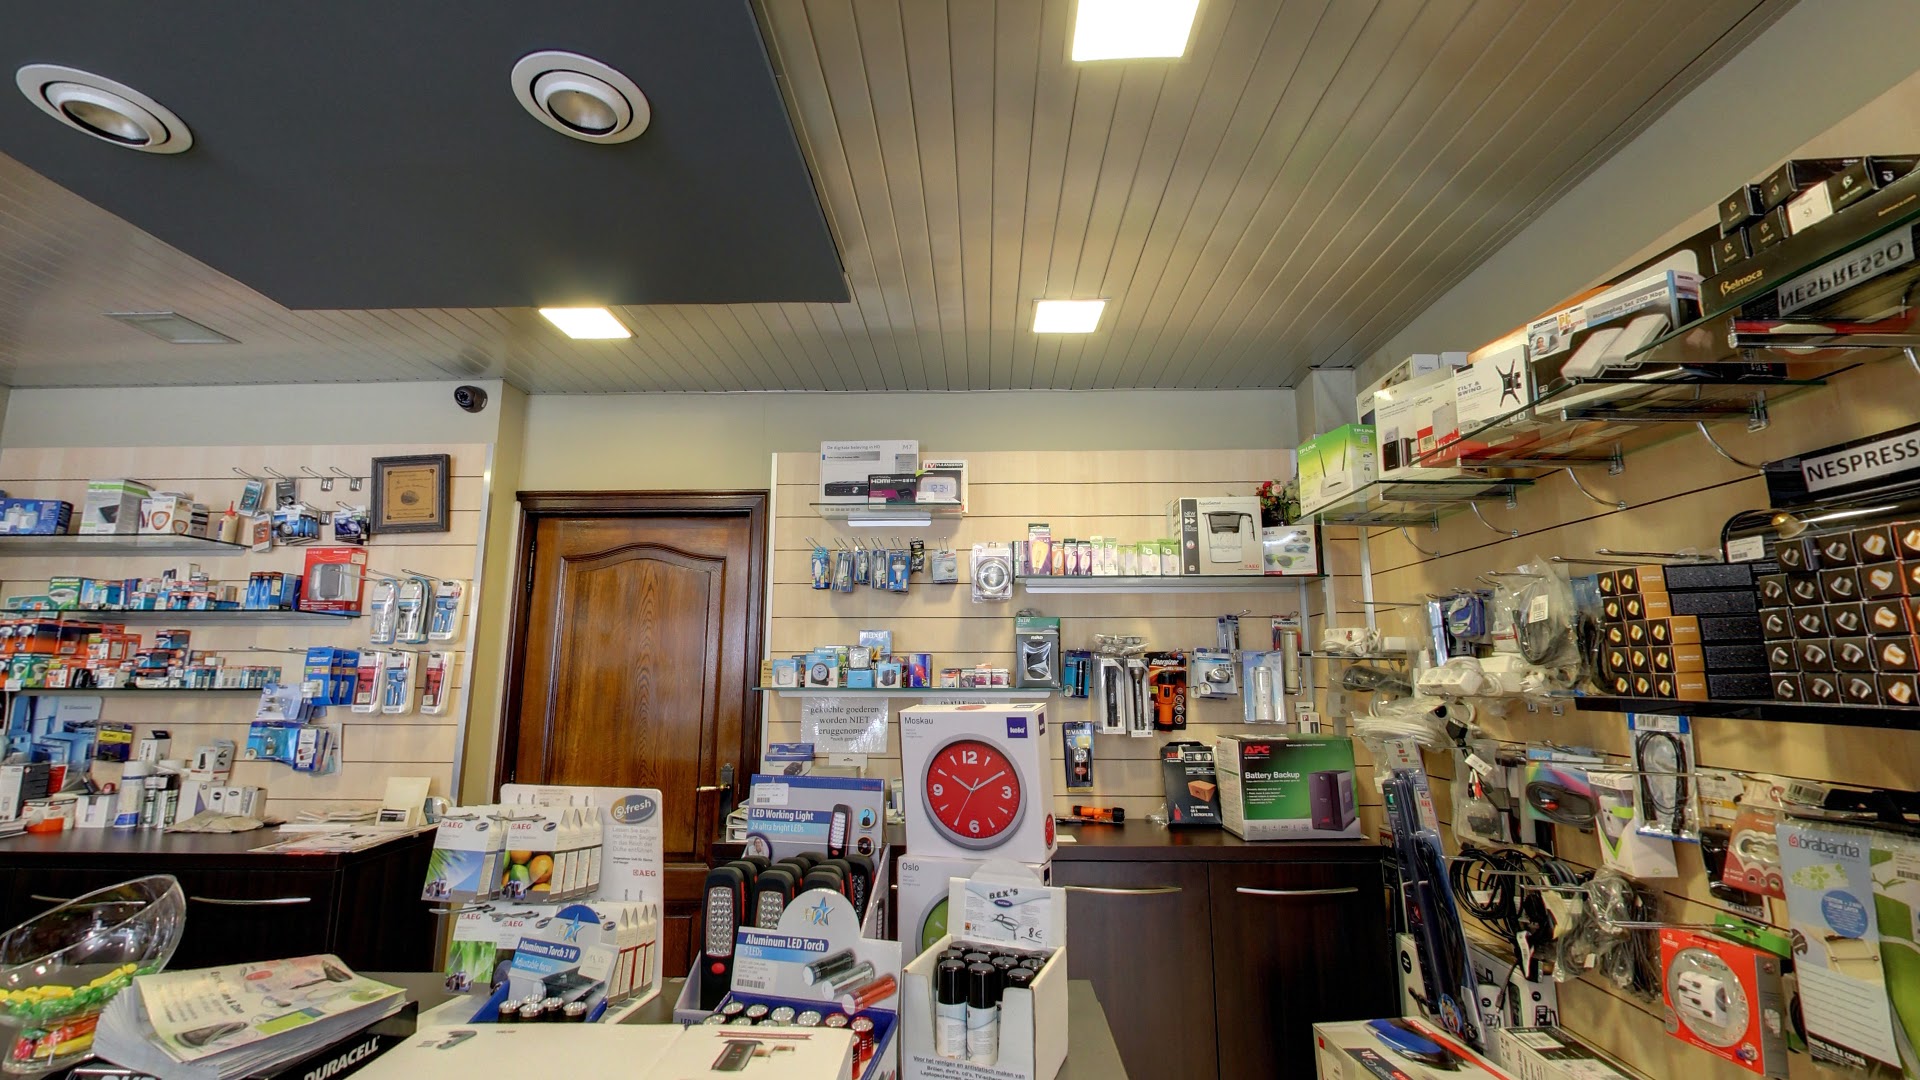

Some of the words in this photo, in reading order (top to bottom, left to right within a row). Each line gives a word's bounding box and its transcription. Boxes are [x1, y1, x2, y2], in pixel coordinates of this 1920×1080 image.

[1720, 269, 1764, 297] Belmoca
[1299, 443, 1317, 455] TP-LINK
[1806, 439, 1920, 482] NESPRESS
[1151, 658, 1179, 666] Energizer
[846, 706, 879, 714] goederen
[904, 716, 934, 725] Moskau
[816, 728, 868, 736] eruggenome
[1244, 745, 1270, 754] APC
[962, 750, 978, 764] 12
[1245, 772, 1272, 780] Battery
[933, 784, 944, 796] 9
[1002, 786, 1012, 799] 3
[752, 808, 764, 818] LED
[766, 810, 794, 822] Working
[795, 811, 814, 822] Light
[773, 823, 790, 834] bright
[790, 824, 804, 832] LEDs
[969, 820, 980, 834] 6
[1798, 835, 1860, 858] brabantia
[902, 862, 920, 872] Oslo
[746, 934, 786, 948] Aluminum
[786, 938, 802, 949] LED
[804, 939, 825, 952] Torch
[519, 940, 548, 954] Aluminum
[548, 944, 564, 958] Torch
[564, 948, 570, 958] 3
[570, 948, 578, 960] W
[750, 946, 762, 957] LEDs
[514, 956, 538, 970] Adjustable
[303, 1036, 380, 1080] DURACELL
[934, 1059, 956, 1068] reinigen
[964, 1064, 994, 1075] antistatisch
[996, 1069, 1014, 1078] maken
